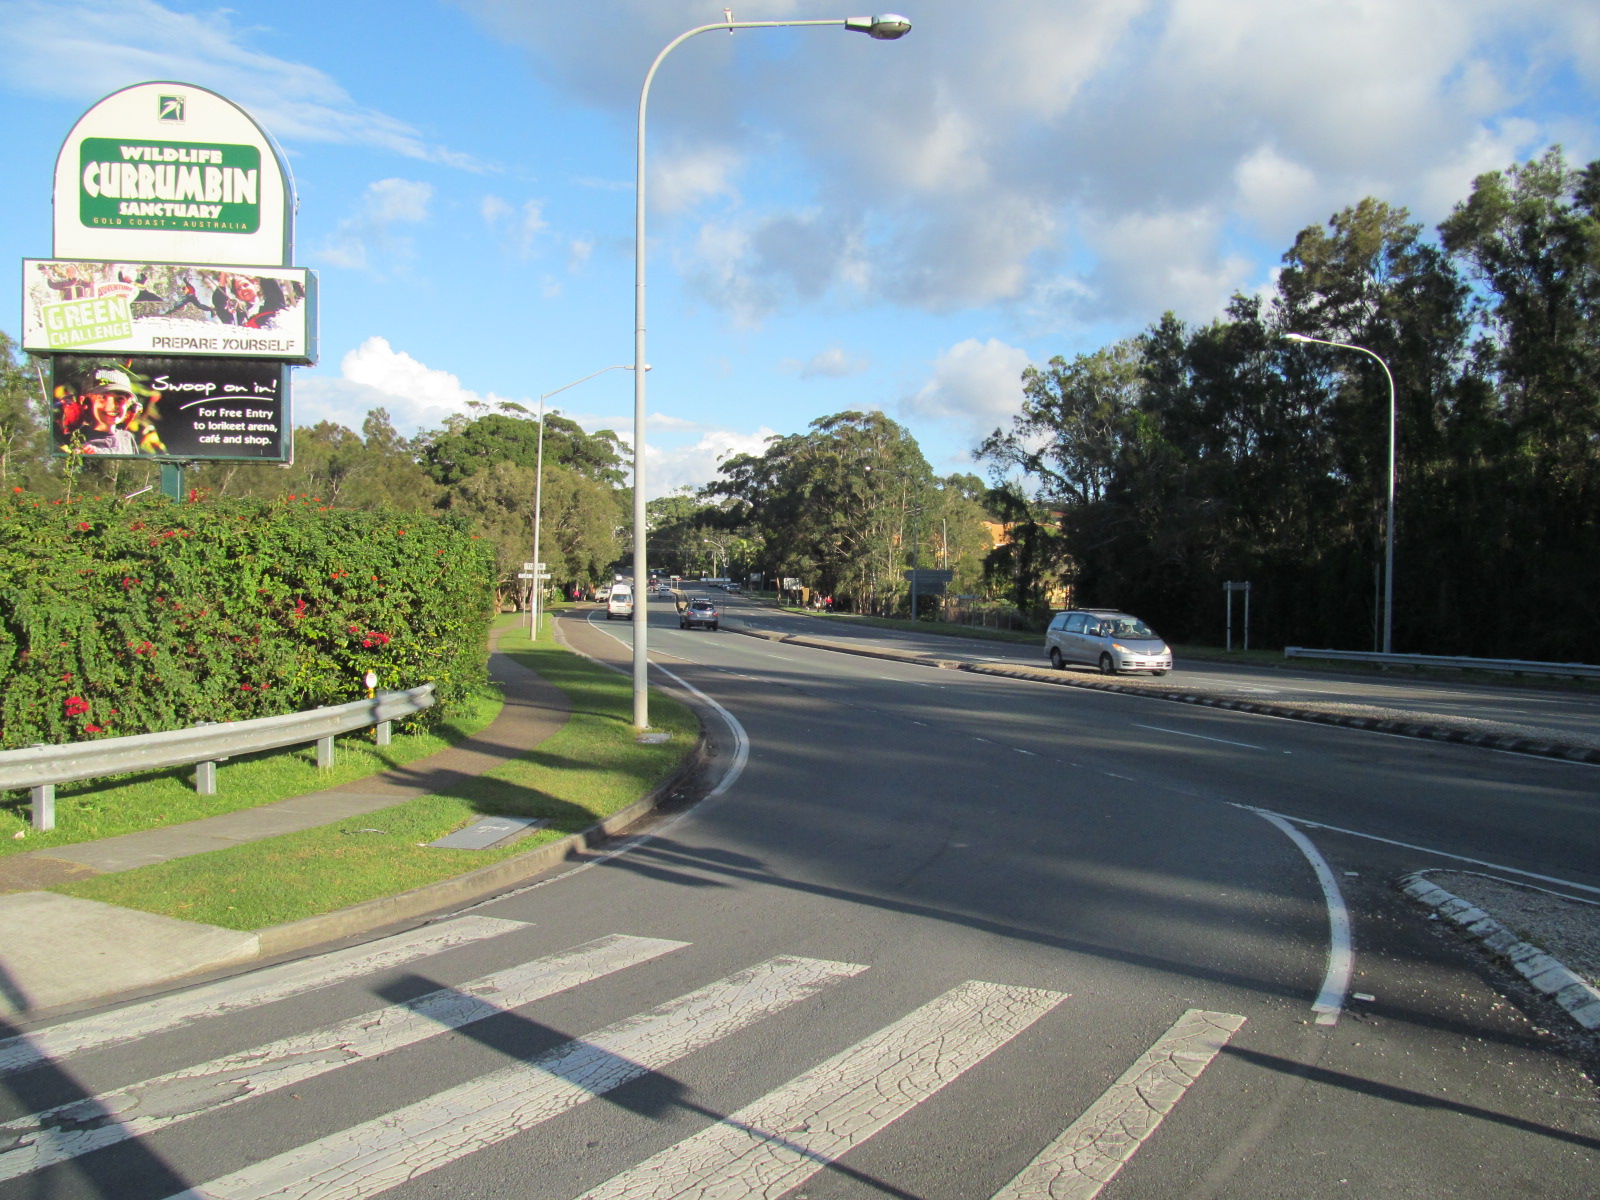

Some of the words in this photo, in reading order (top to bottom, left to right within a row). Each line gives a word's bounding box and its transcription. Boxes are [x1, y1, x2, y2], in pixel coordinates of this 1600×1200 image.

[120, 146, 223, 164] WILDLIFE
[83, 161, 258, 204] CURRUMBIN
[119, 202, 223, 219] SANCTUARY
[93, 217, 122, 225] GOLD
[129, 218, 166, 226] COAST
[183, 220, 248, 230] AUSTRALIA
[47, 297, 128, 331] GREEN
[50, 322, 131, 346] CHALLENGE
[152, 337, 218, 350] PREPARE
[222, 339, 295, 352] YOURSELF
[152, 375, 216, 396] Swoop
[223, 384, 248, 393] on
[253, 379, 277, 393] in!
[199, 408, 217, 417] For
[219, 408, 242, 418] Free
[246, 408, 273, 420] Entry
[193, 421, 206, 430] to
[208, 421, 246, 431] lorikeet
[247, 424, 278, 433] arena,
[199, 434, 221, 444] café
[223, 435, 242, 444] and
[244, 435, 272, 446] shop.
